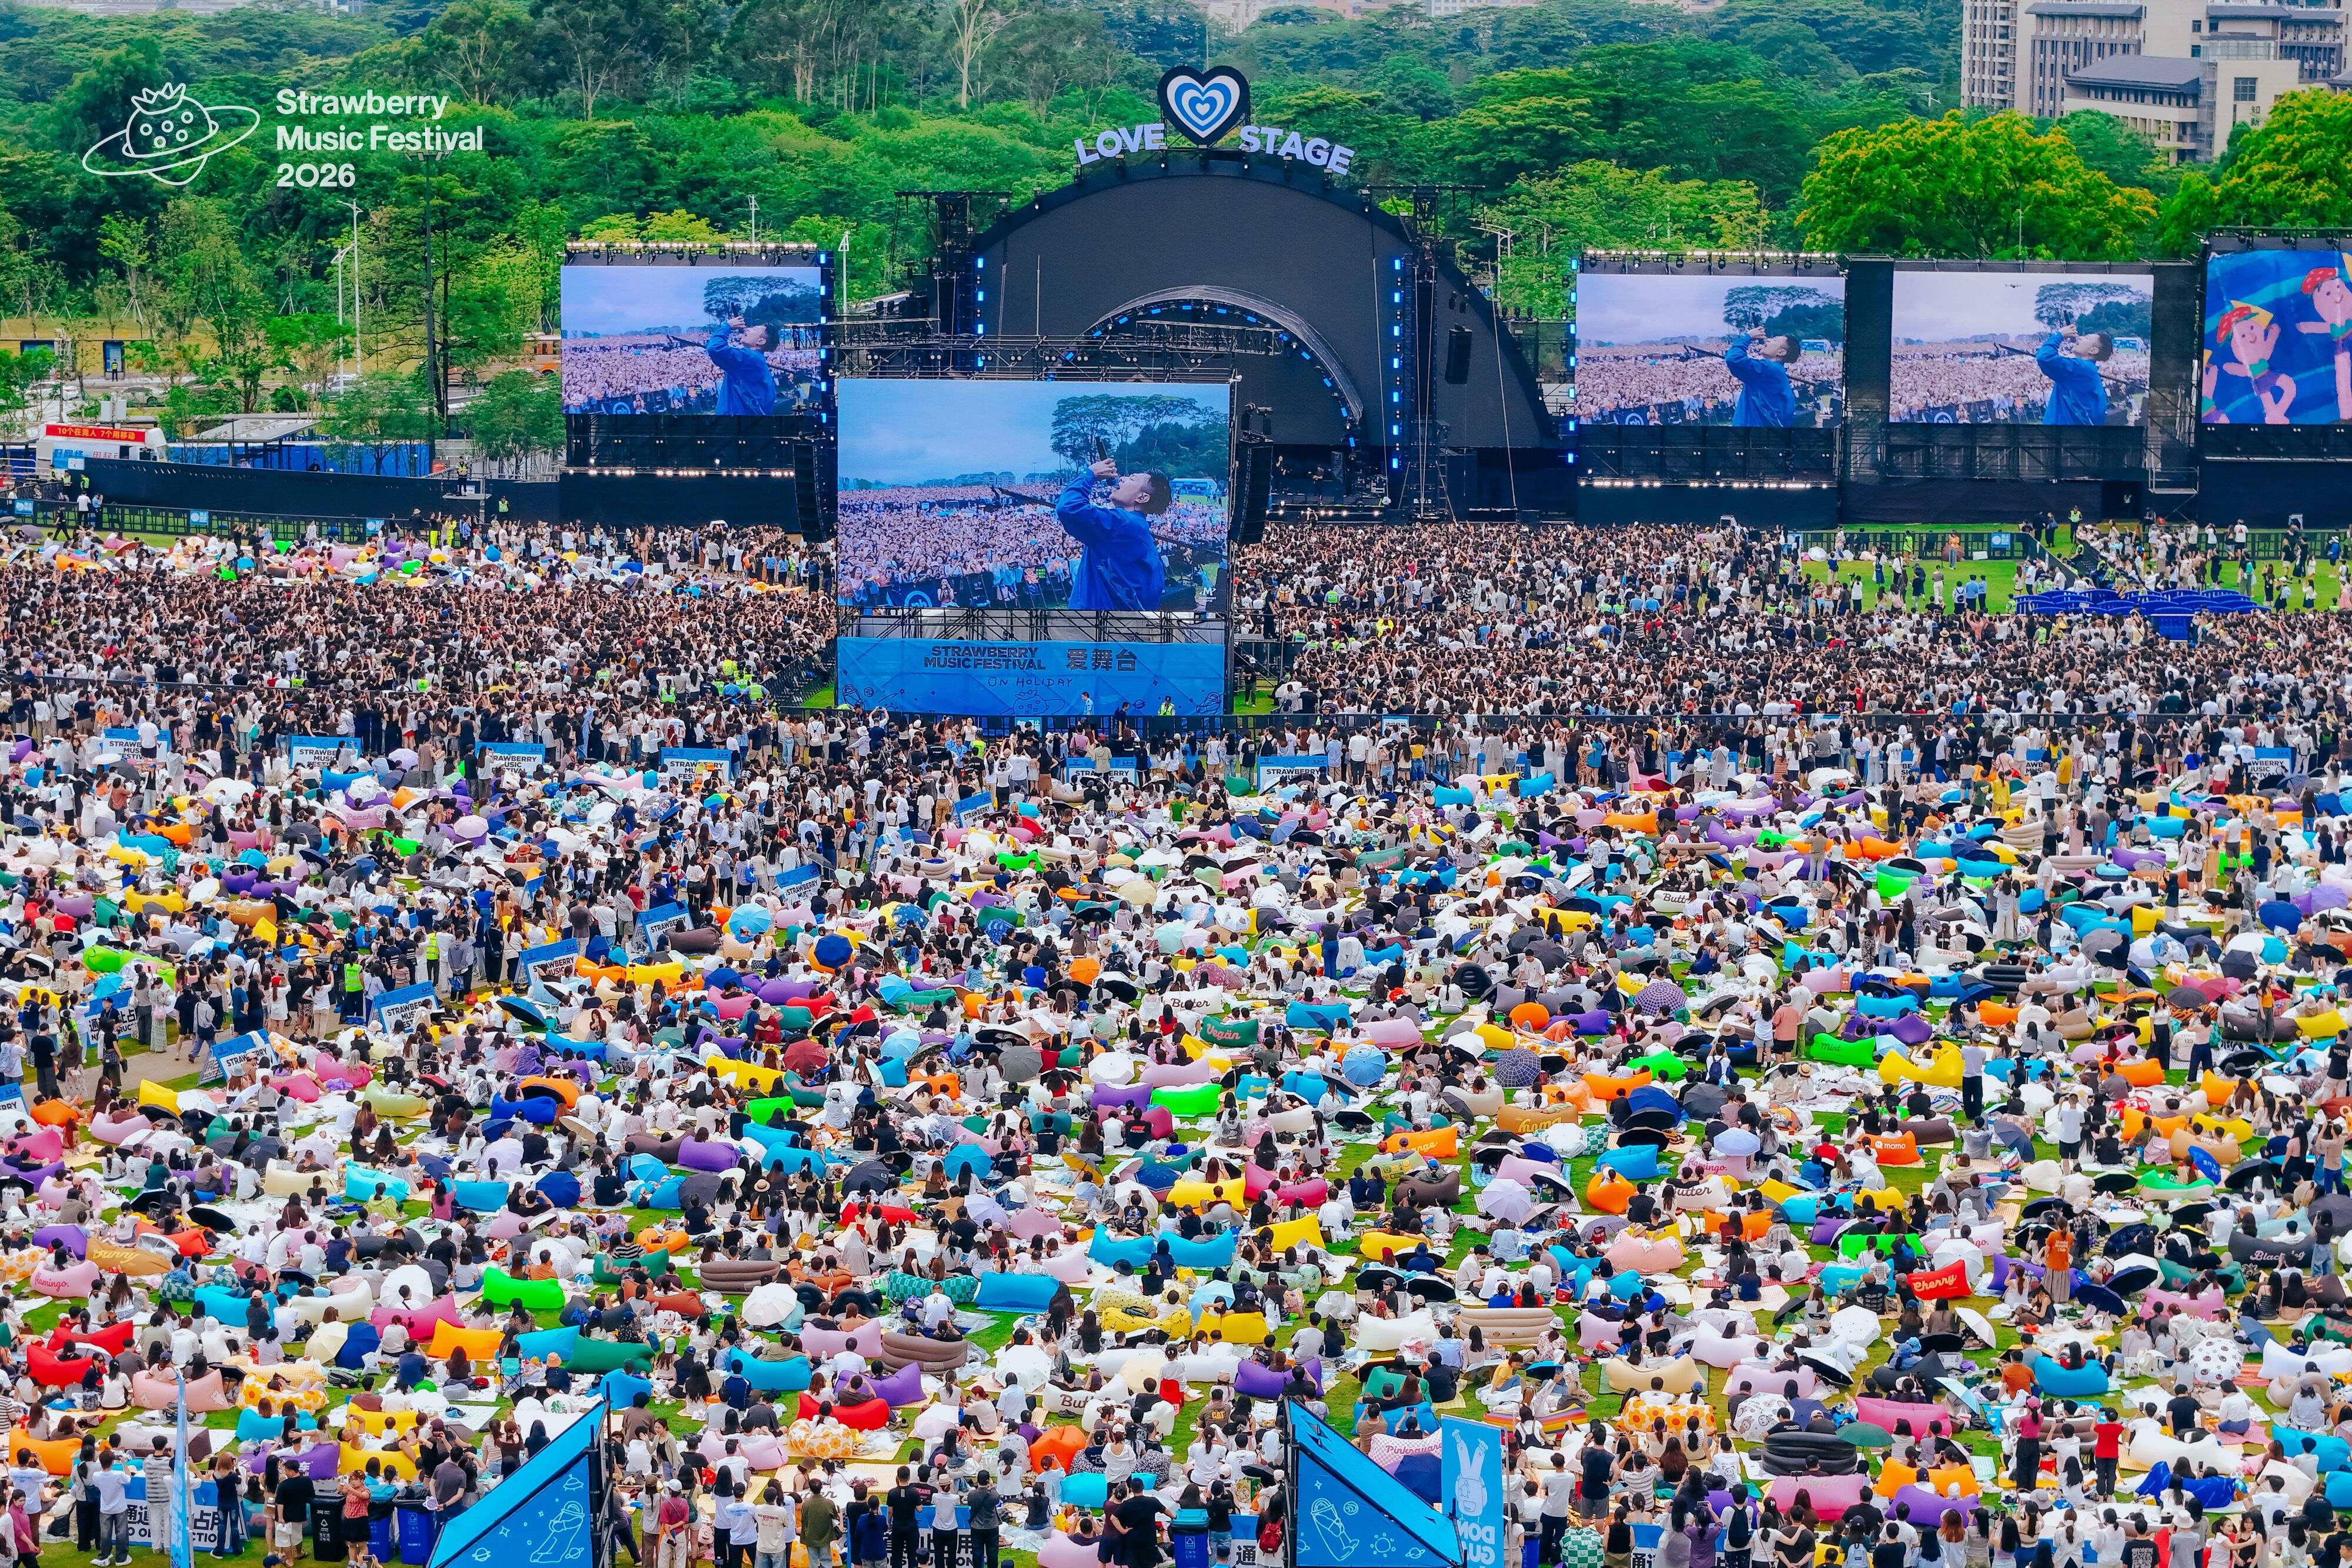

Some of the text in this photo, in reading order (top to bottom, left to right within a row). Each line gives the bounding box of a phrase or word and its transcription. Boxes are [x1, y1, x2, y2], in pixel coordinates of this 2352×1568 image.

[1074, 123, 1355, 176] LOVE STAGE
[932, 646, 1038, 658] STRAWBERRY
[924, 657, 1046, 671] MUSIC FESTIVAL
[1066, 648, 1138, 671] 爱舞台
[988, 677, 1074, 687] ON HOLIDAY
[963, 805, 990, 821] STRAWBERRY
[787, 879, 818, 896] STRAWBERRY
[1439, 898, 1449, 908] 23
[1171, 998, 1211, 1008] Buter
[1820, 1042, 1841, 1051] Mint
[1912, 1275, 1957, 1292] Cherry
[1211, 1411, 1225, 1419] CAT
